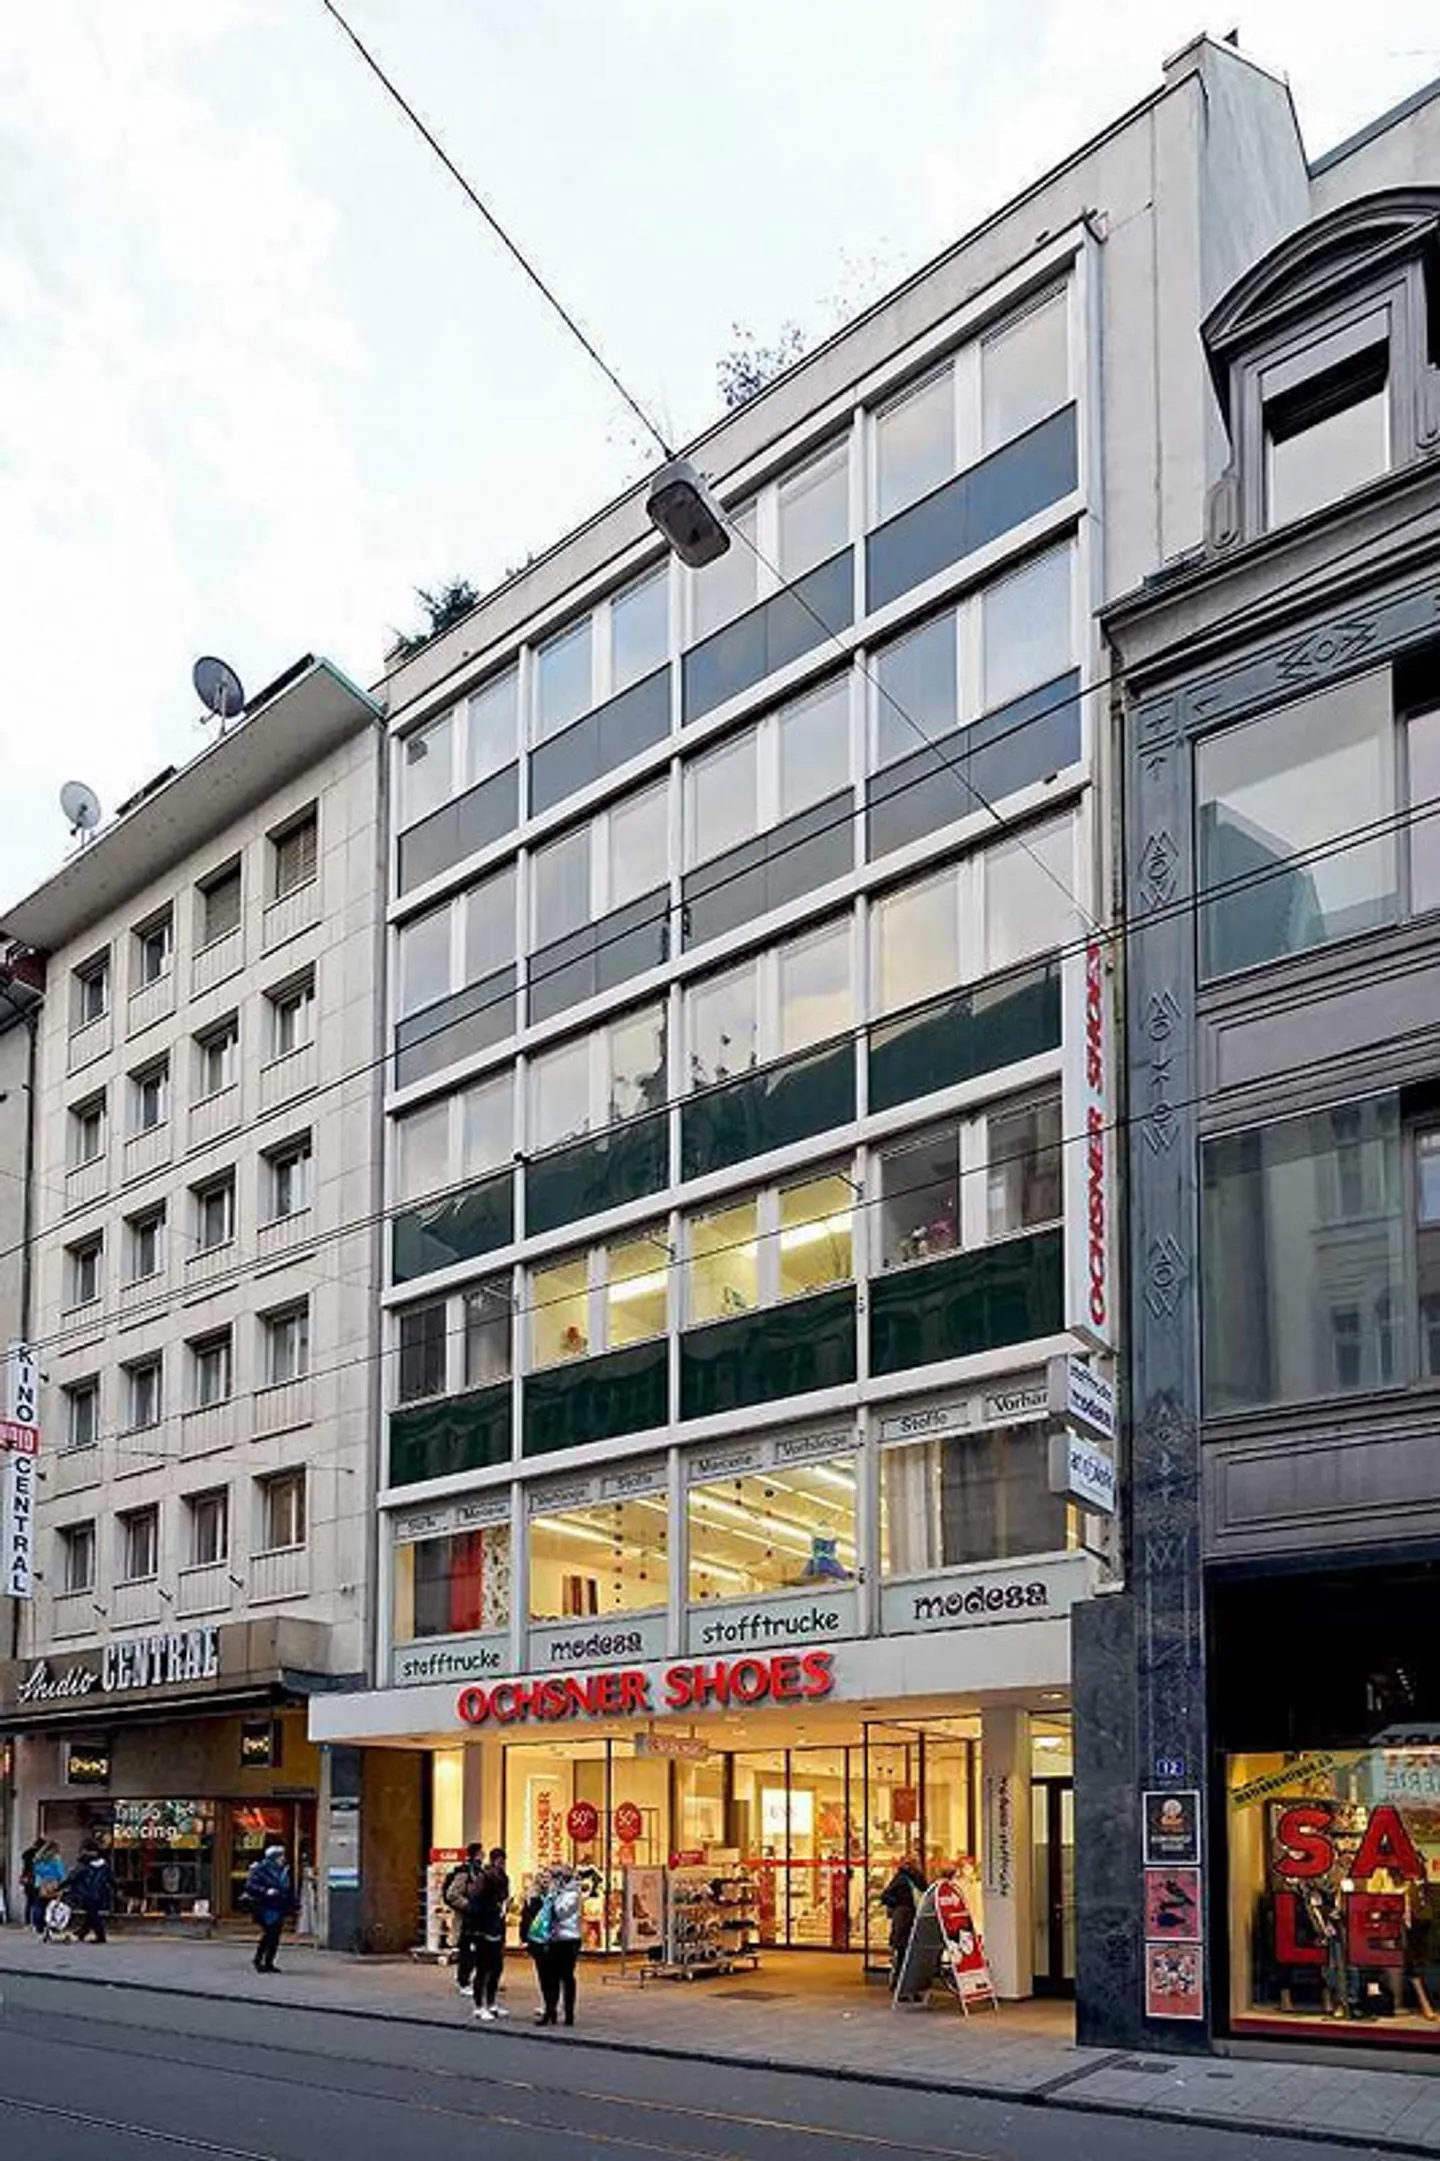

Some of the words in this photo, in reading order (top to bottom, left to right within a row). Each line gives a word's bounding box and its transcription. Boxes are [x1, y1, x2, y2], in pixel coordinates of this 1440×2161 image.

[1088, 1106, 1105, 1326] OCHSNER
[17, 1345, 34, 1422] KINO
[11, 1456, 31, 1593] CENTRAL
[702, 1606, 841, 1646] stofftrucke
[913, 1581, 1050, 1622] modesa
[102, 1625, 217, 1693] CENTRAL
[402, 1647, 501, 1678] stofftrucke
[550, 1631, 642, 1662] modesa
[457, 1671, 650, 1724] OCHSNER
[664, 1650, 835, 1711] SHOES
